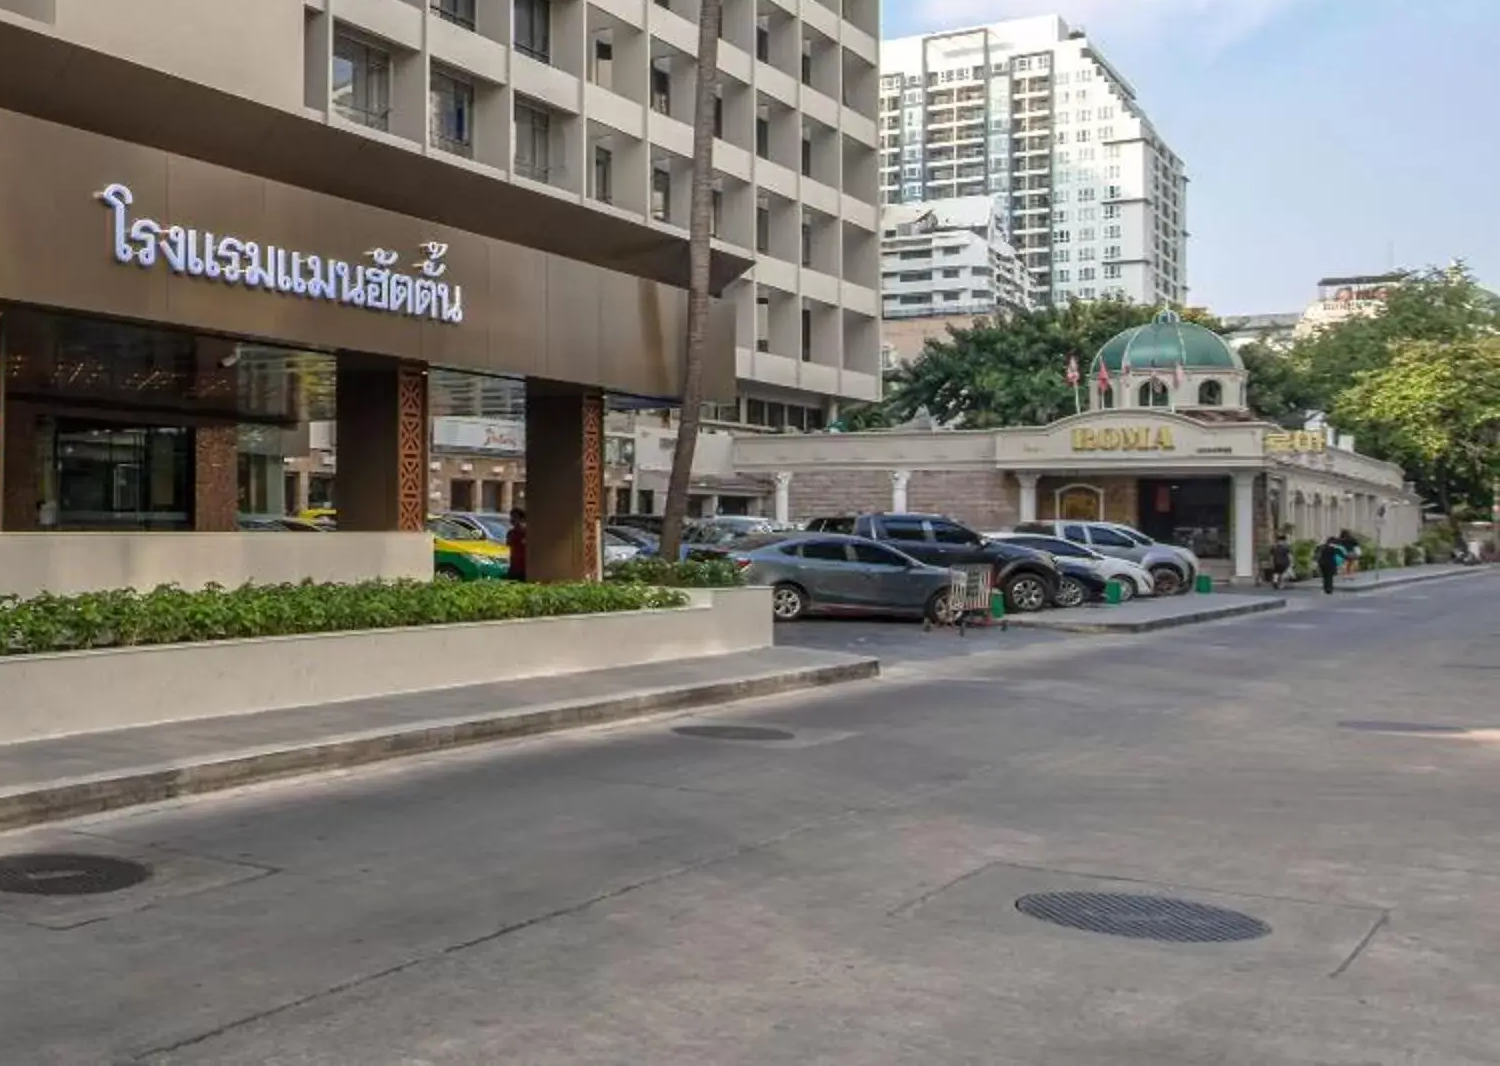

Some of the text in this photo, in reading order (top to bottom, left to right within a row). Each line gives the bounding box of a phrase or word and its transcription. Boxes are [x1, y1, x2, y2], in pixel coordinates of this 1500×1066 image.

[102, 183, 463, 323] โรงแรมแมนฮัตตั้น
[1071, 425, 1174, 451] ROMA
